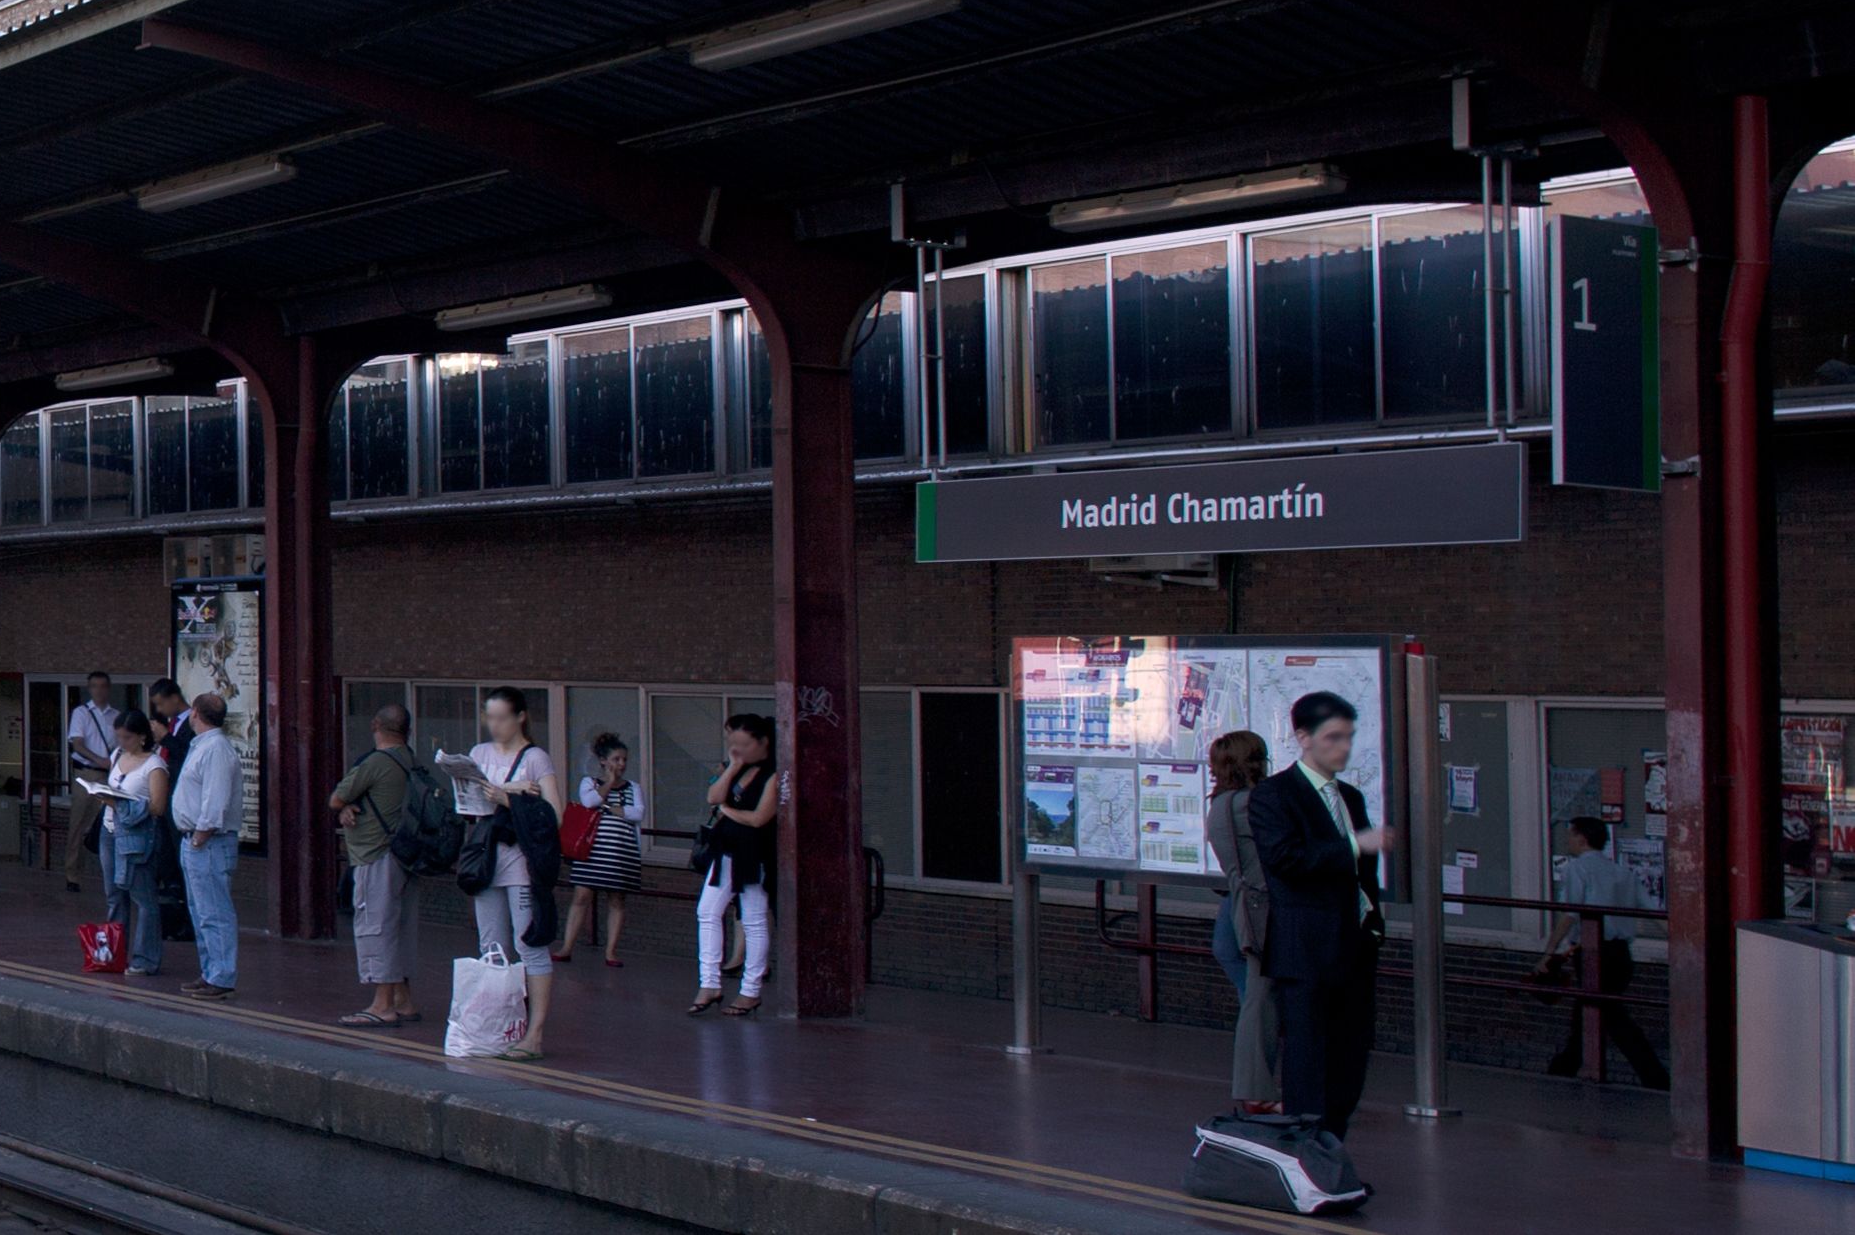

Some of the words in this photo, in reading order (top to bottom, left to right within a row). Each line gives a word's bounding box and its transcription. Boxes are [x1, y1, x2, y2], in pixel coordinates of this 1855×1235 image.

[1572, 277, 1597, 332] 1
[1061, 493, 1156, 528] Madrid
[1167, 483, 1324, 524] Chamartín
